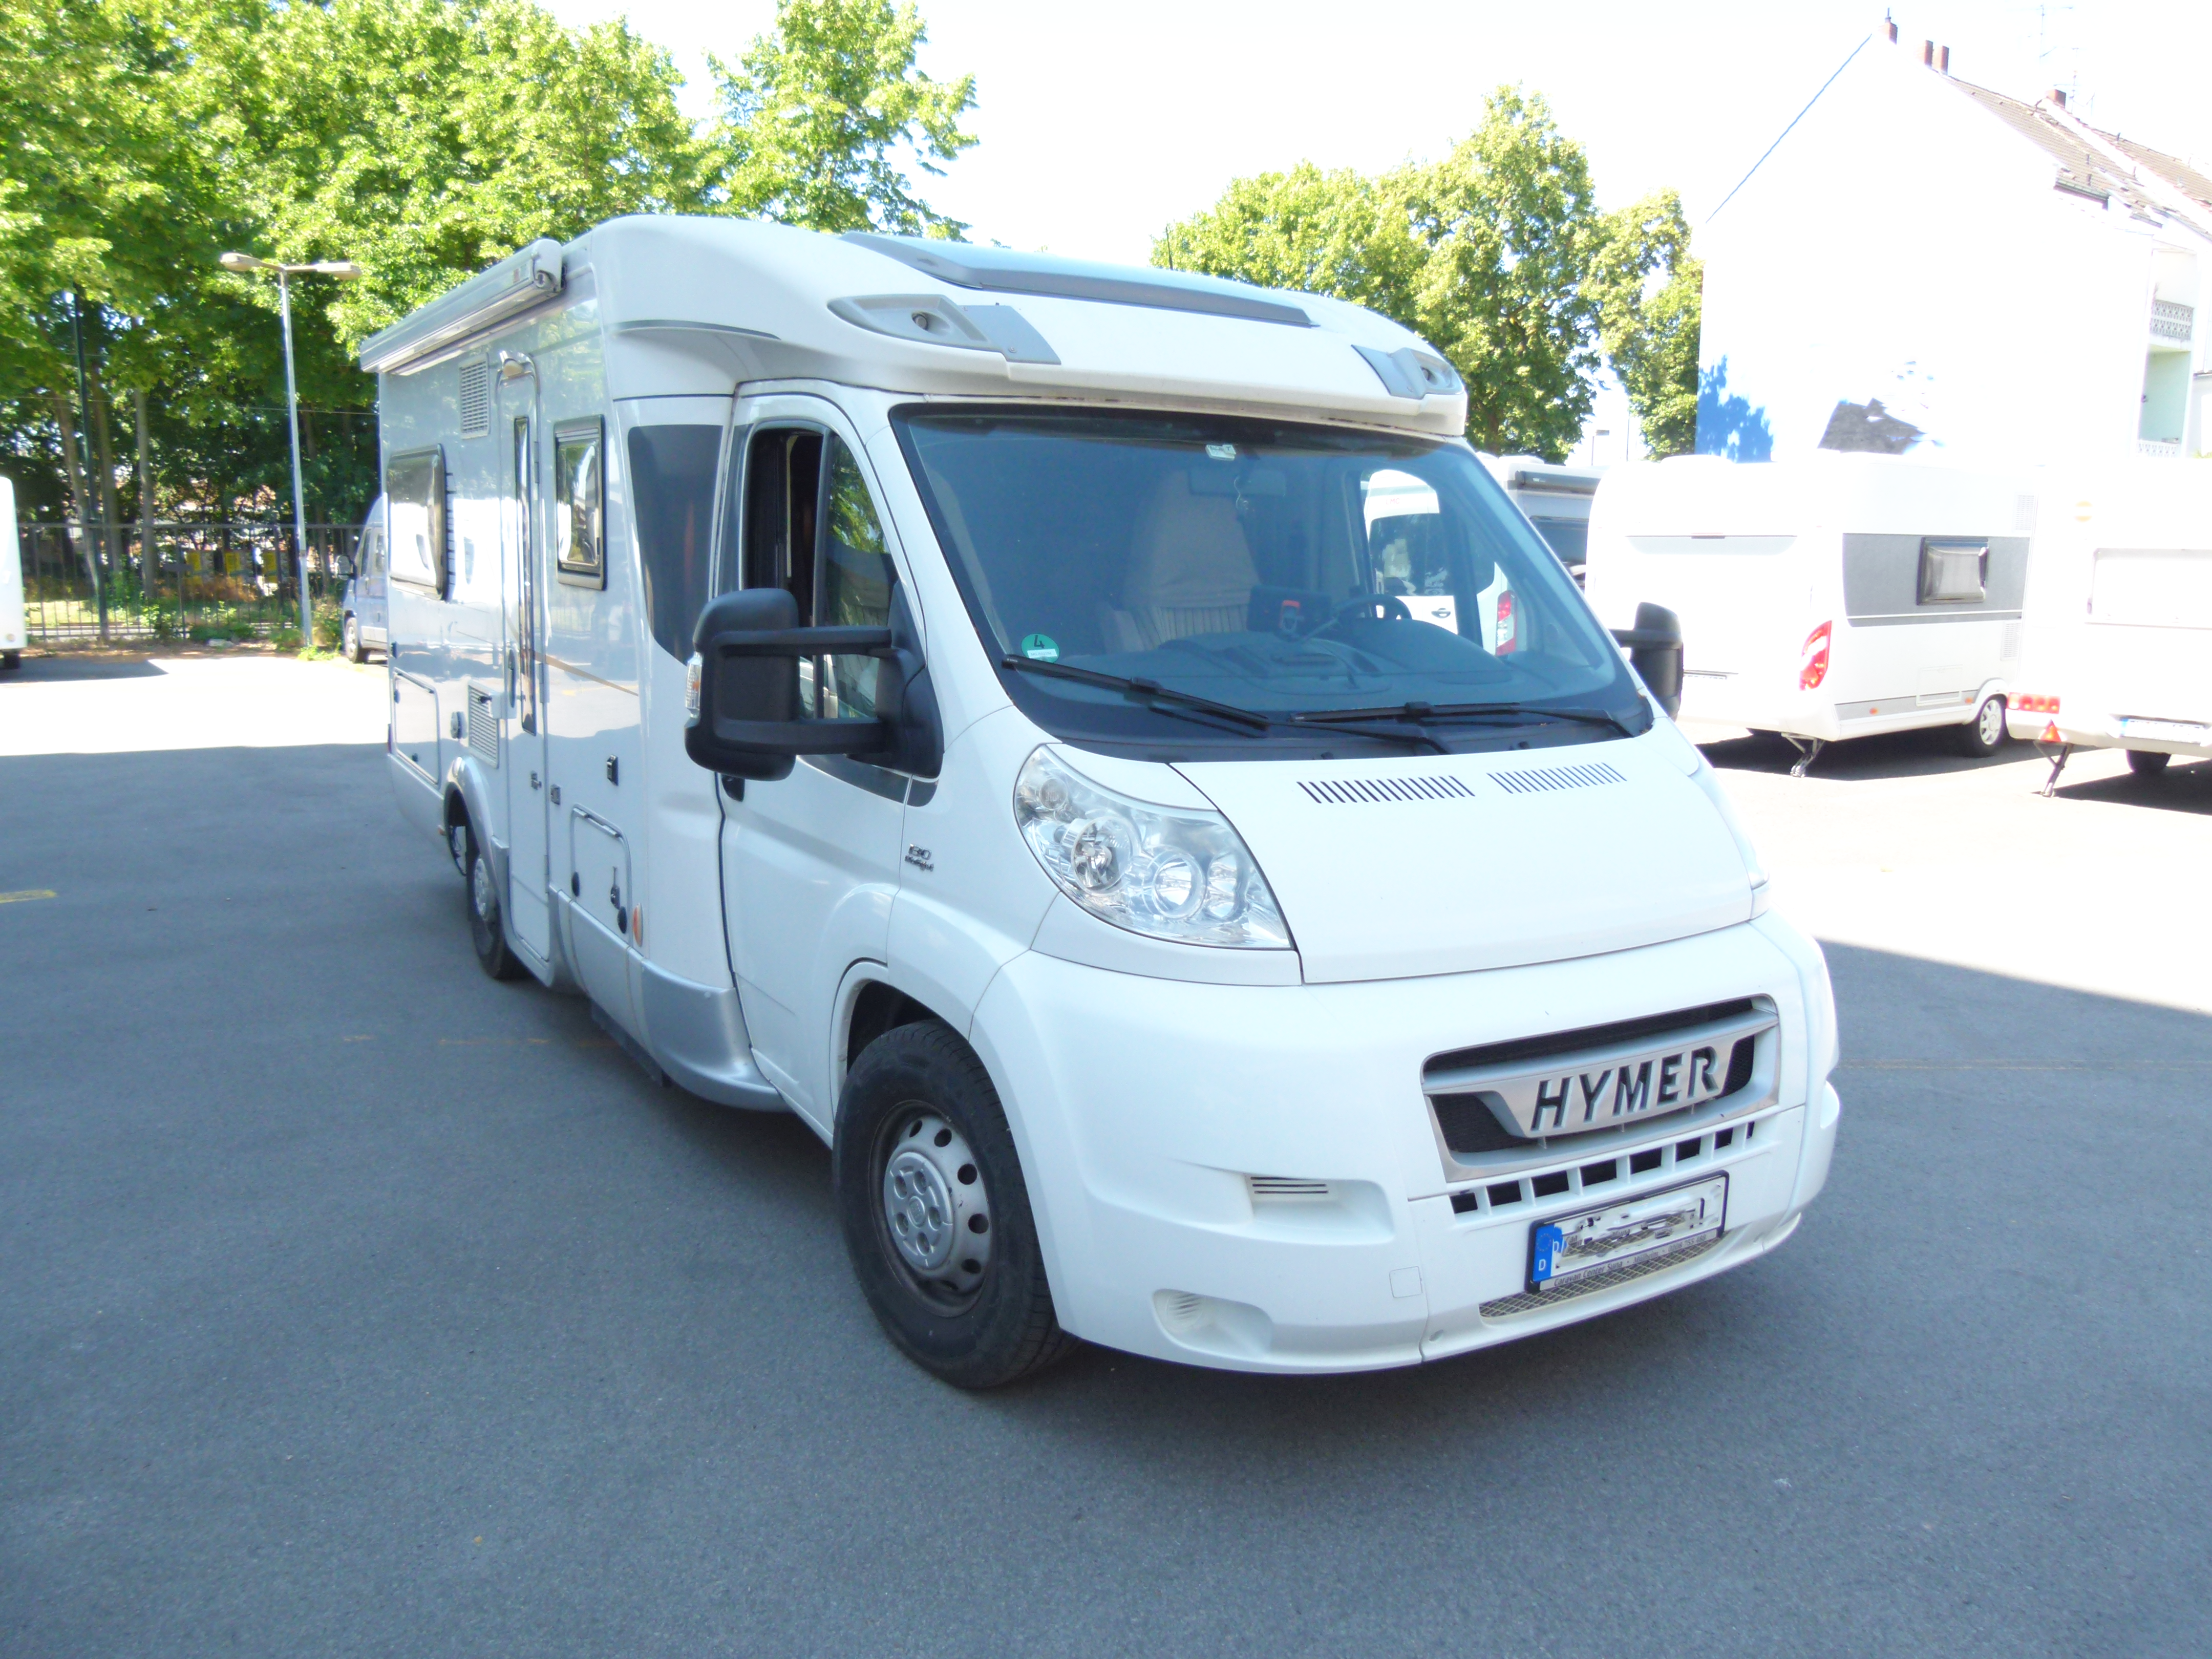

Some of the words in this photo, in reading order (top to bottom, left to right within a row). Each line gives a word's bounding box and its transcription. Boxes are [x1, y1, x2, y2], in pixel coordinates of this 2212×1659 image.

[1034, 635, 1045, 649] 4
[1531, 1046, 1719, 1131] HYMER
[1539, 1259, 1546, 1271] D
[1554, 1272, 1581, 1286] Caravan
[1583, 1266, 1605, 1278] Center
